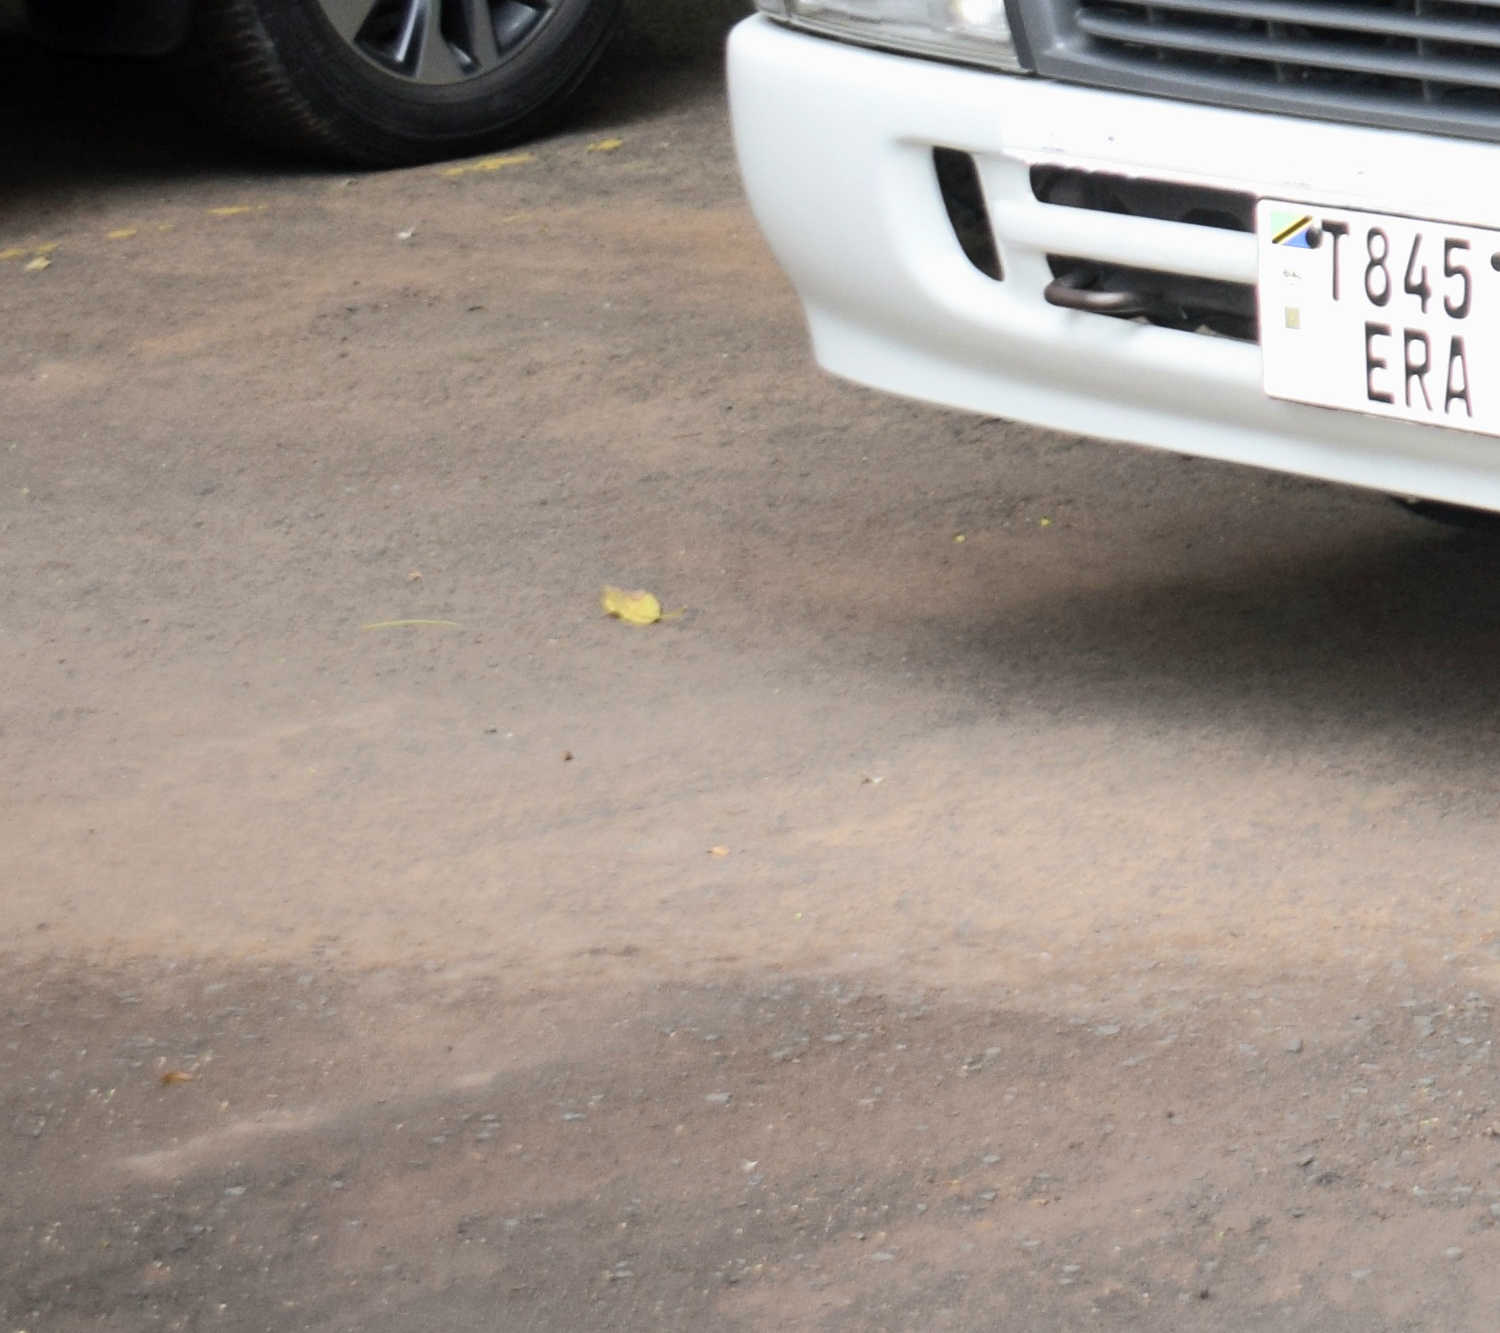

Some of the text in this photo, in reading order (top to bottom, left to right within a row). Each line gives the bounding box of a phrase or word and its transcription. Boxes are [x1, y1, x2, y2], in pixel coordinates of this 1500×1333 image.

[1321, 218, 1473, 320] T 845
[1364, 320, 1473, 418] ERA
